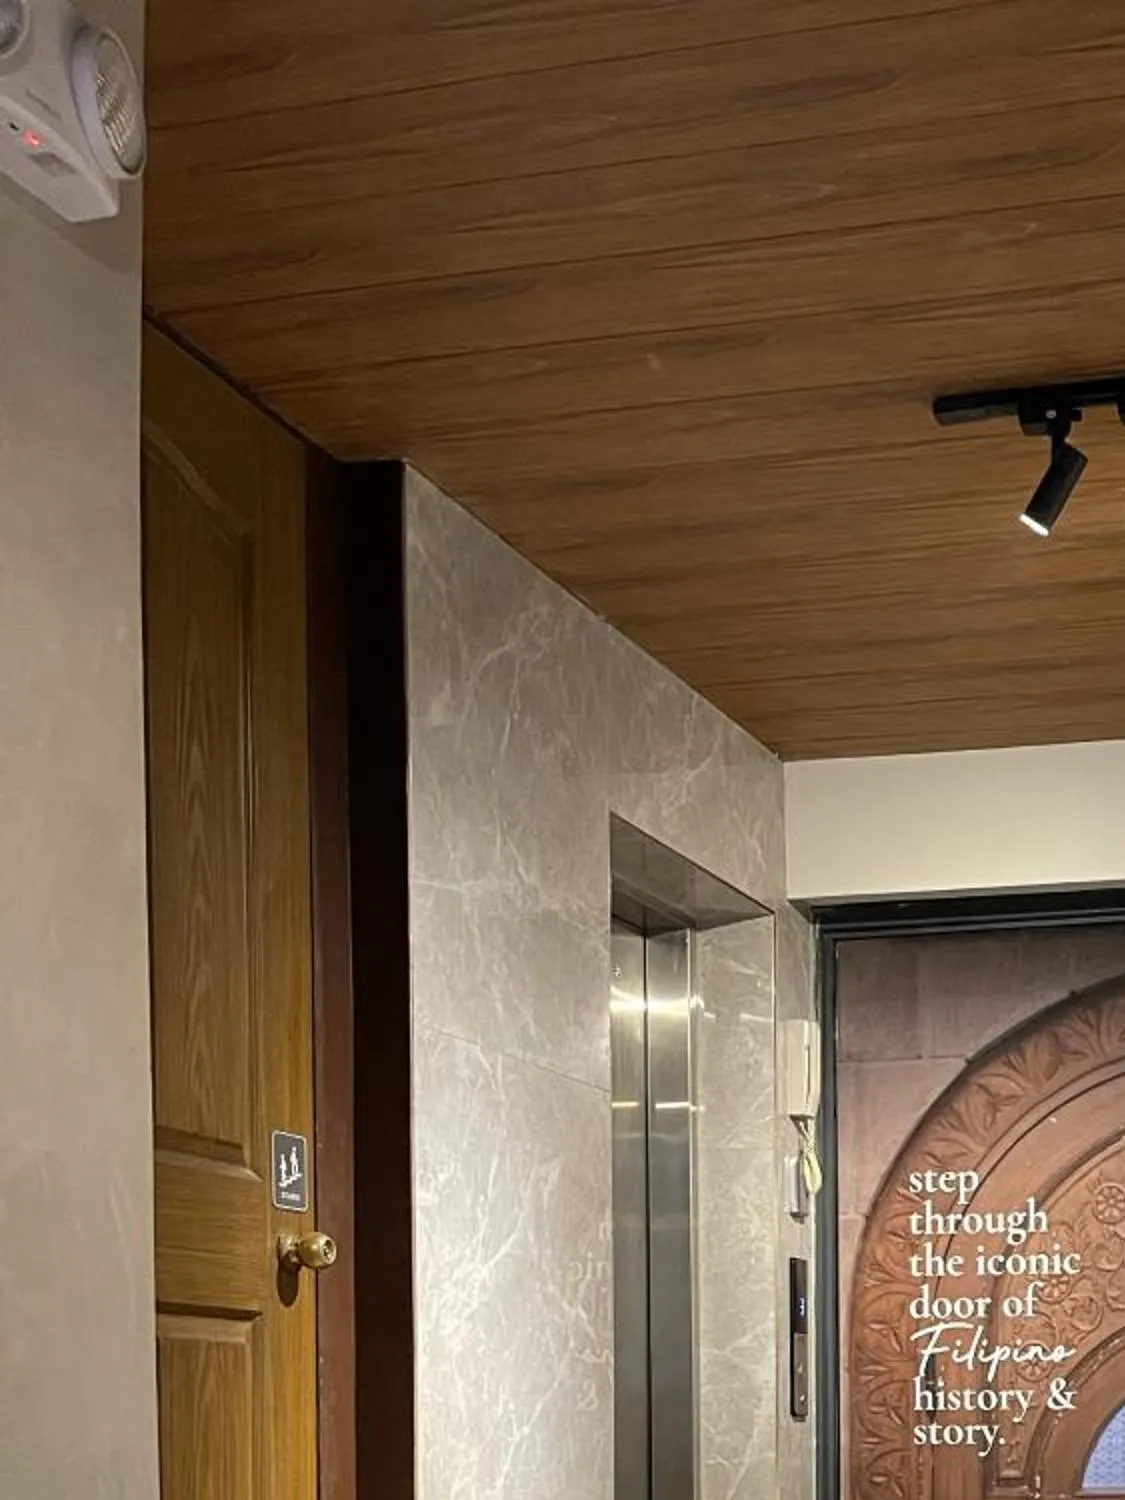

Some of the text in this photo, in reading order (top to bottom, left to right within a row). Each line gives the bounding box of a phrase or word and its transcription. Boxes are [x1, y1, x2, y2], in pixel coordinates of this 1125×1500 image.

[909, 1169, 979, 1204] step
[910, 1197, 1049, 1245] through
[910, 1243, 1081, 1276] the iconic
[910, 1281, 1044, 1320] door of
[910, 1321, 1077, 1382] Filipino
[913, 1375, 1077, 1422] history &
[913, 1421, 1006, 1457] story.
